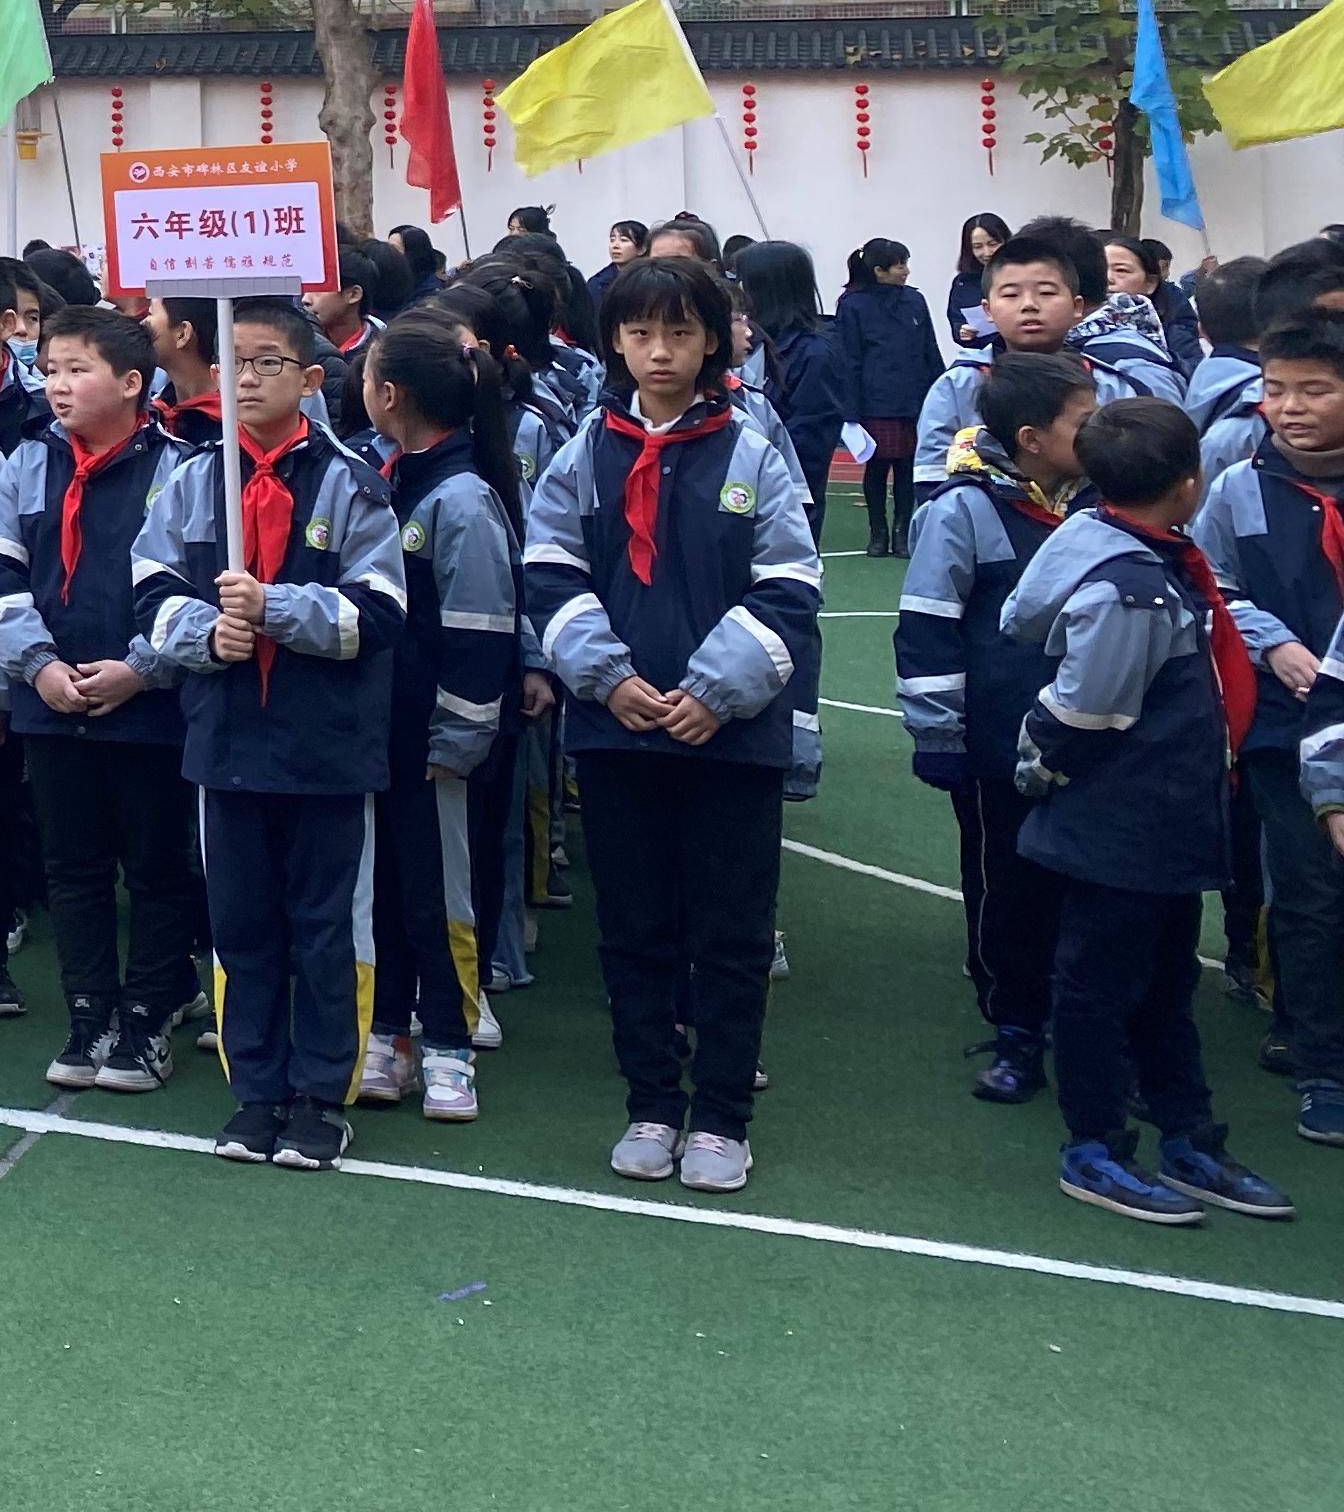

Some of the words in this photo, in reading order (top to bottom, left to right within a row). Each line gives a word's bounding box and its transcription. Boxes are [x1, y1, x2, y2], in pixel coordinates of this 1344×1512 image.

[152, 157, 299, 178] 西安市碑林区友谊小学
[130, 205, 307, 240] 六年级(1)班
